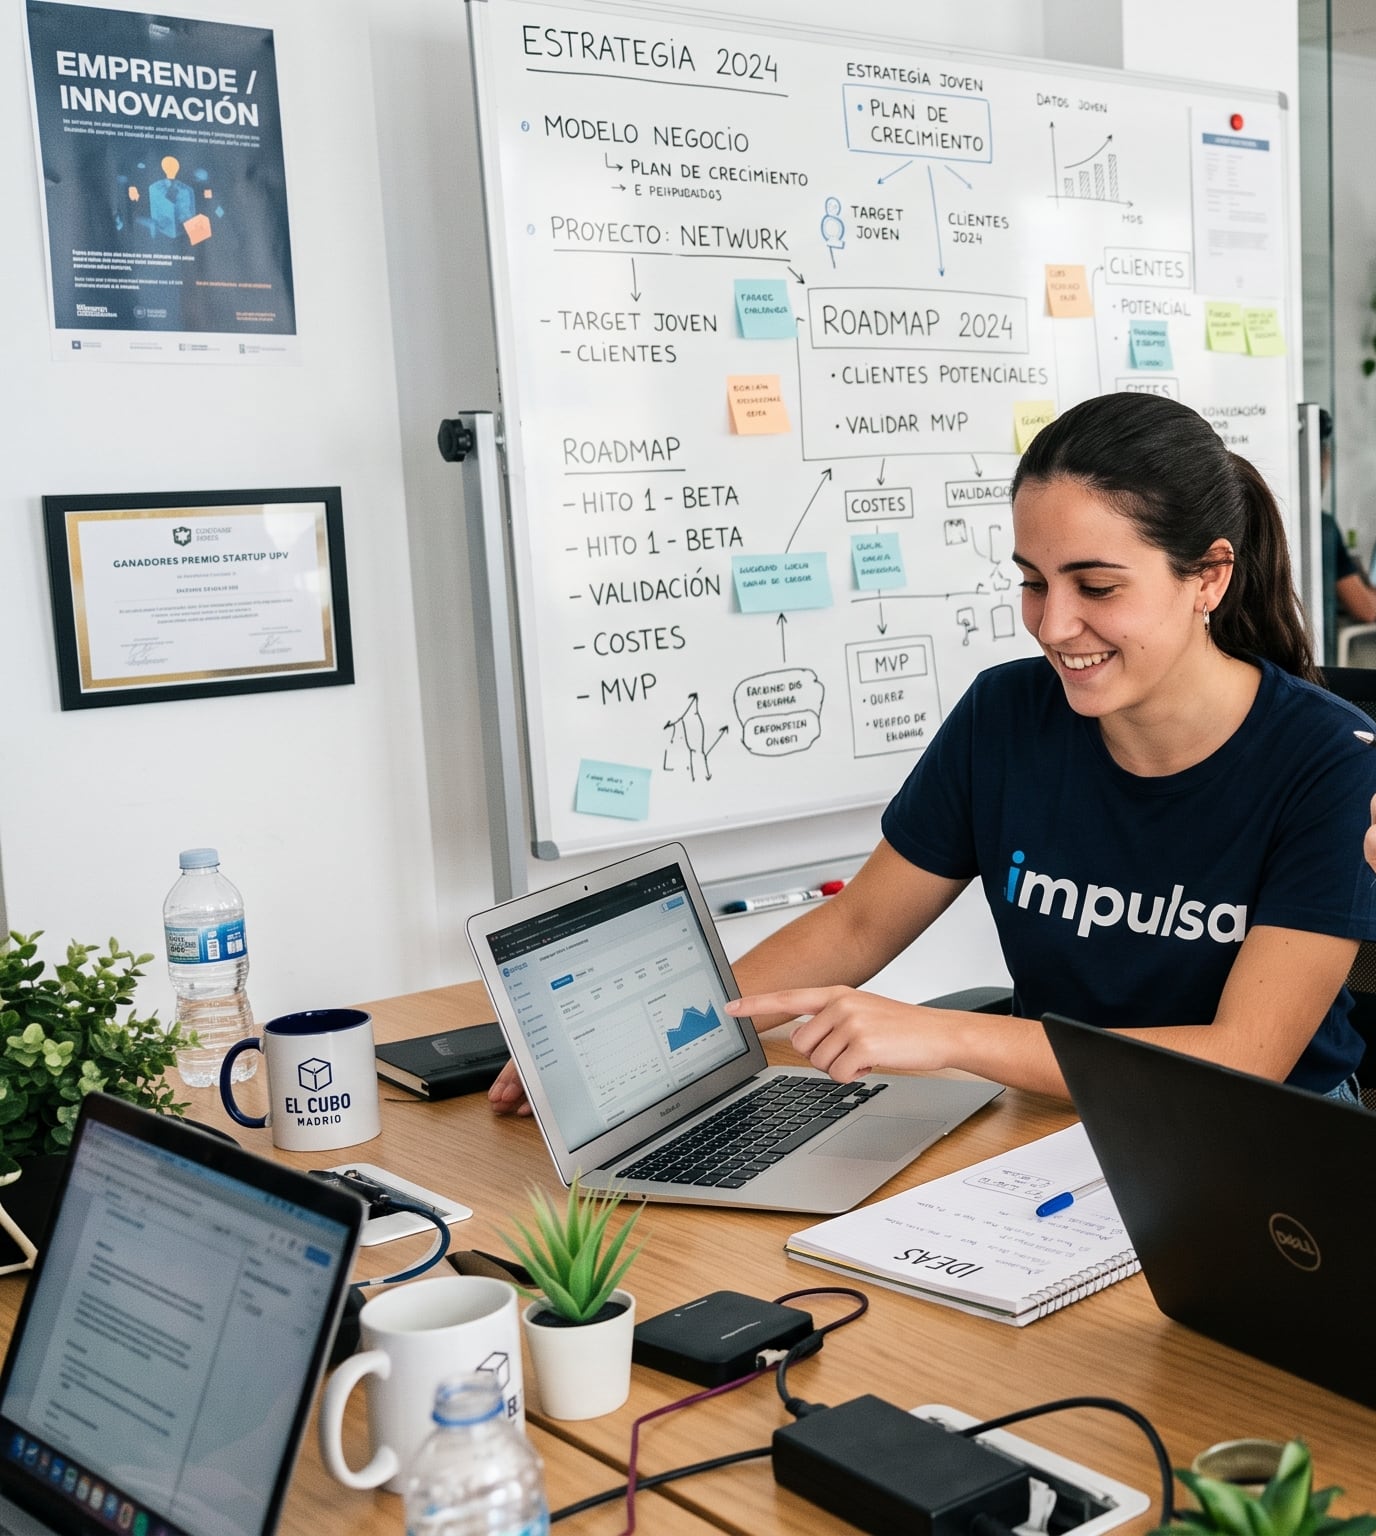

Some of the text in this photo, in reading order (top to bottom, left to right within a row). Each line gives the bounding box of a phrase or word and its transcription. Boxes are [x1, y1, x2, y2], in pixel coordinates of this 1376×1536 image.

[522, 25, 778, 82] ESTRATEGIA 2024
[56, 50, 258, 95] EMPRENDE /
[847, 62, 983, 92] ESTRATEGIA JOVEN
[59, 84, 259, 127] INNOVACIÓN
[870, 98, 949, 123] PLAN DE
[1036, 92, 1069, 108] DATOS
[544, 115, 749, 153] MODELO NEGOCIO
[871, 125, 983, 152] CRECIMIENTO
[631, 159, 808, 187] PLAN DE CRECIMIENTO
[851, 205, 1009, 230] TARGET CLIENTES
[857, 225, 900, 241] JOVEN
[1110, 255, 1184, 279] CLIENTES
[1121, 298, 1192, 316] POTENCIAL
[557, 310, 717, 332] TARGET JOVEN
[822, 304, 940, 336] ROADMAP
[958, 311, 1013, 340] 2024
[577, 342, 677, 363] CLIENTES
[842, 362, 1049, 385] CLIENTES POTENCIALES
[845, 411, 969, 434] VALIDAR MVP
[563, 436, 681, 465] ROADMAP
[582, 491, 633, 514] HITO
[644, 487, 656, 511] 1
[682, 485, 739, 509] BETA
[851, 496, 906, 514] COSTES
[586, 535, 637, 558] HITO
[647, 530, 660, 555] 1
[686, 525, 744, 551] BETA
[113, 551, 289, 568] GANADORES PREMIO STARTUP UPV
[589, 566, 721, 606] VALIDACIÓN
[593, 625, 686, 656] COSTES
[875, 653, 909, 673] MVP
[601, 673, 657, 705] MVP
[1006, 850, 1248, 943] impulsa
[285, 1093, 351, 1114] EL CUBO
[893, 1248, 984, 1279] IDEAS
